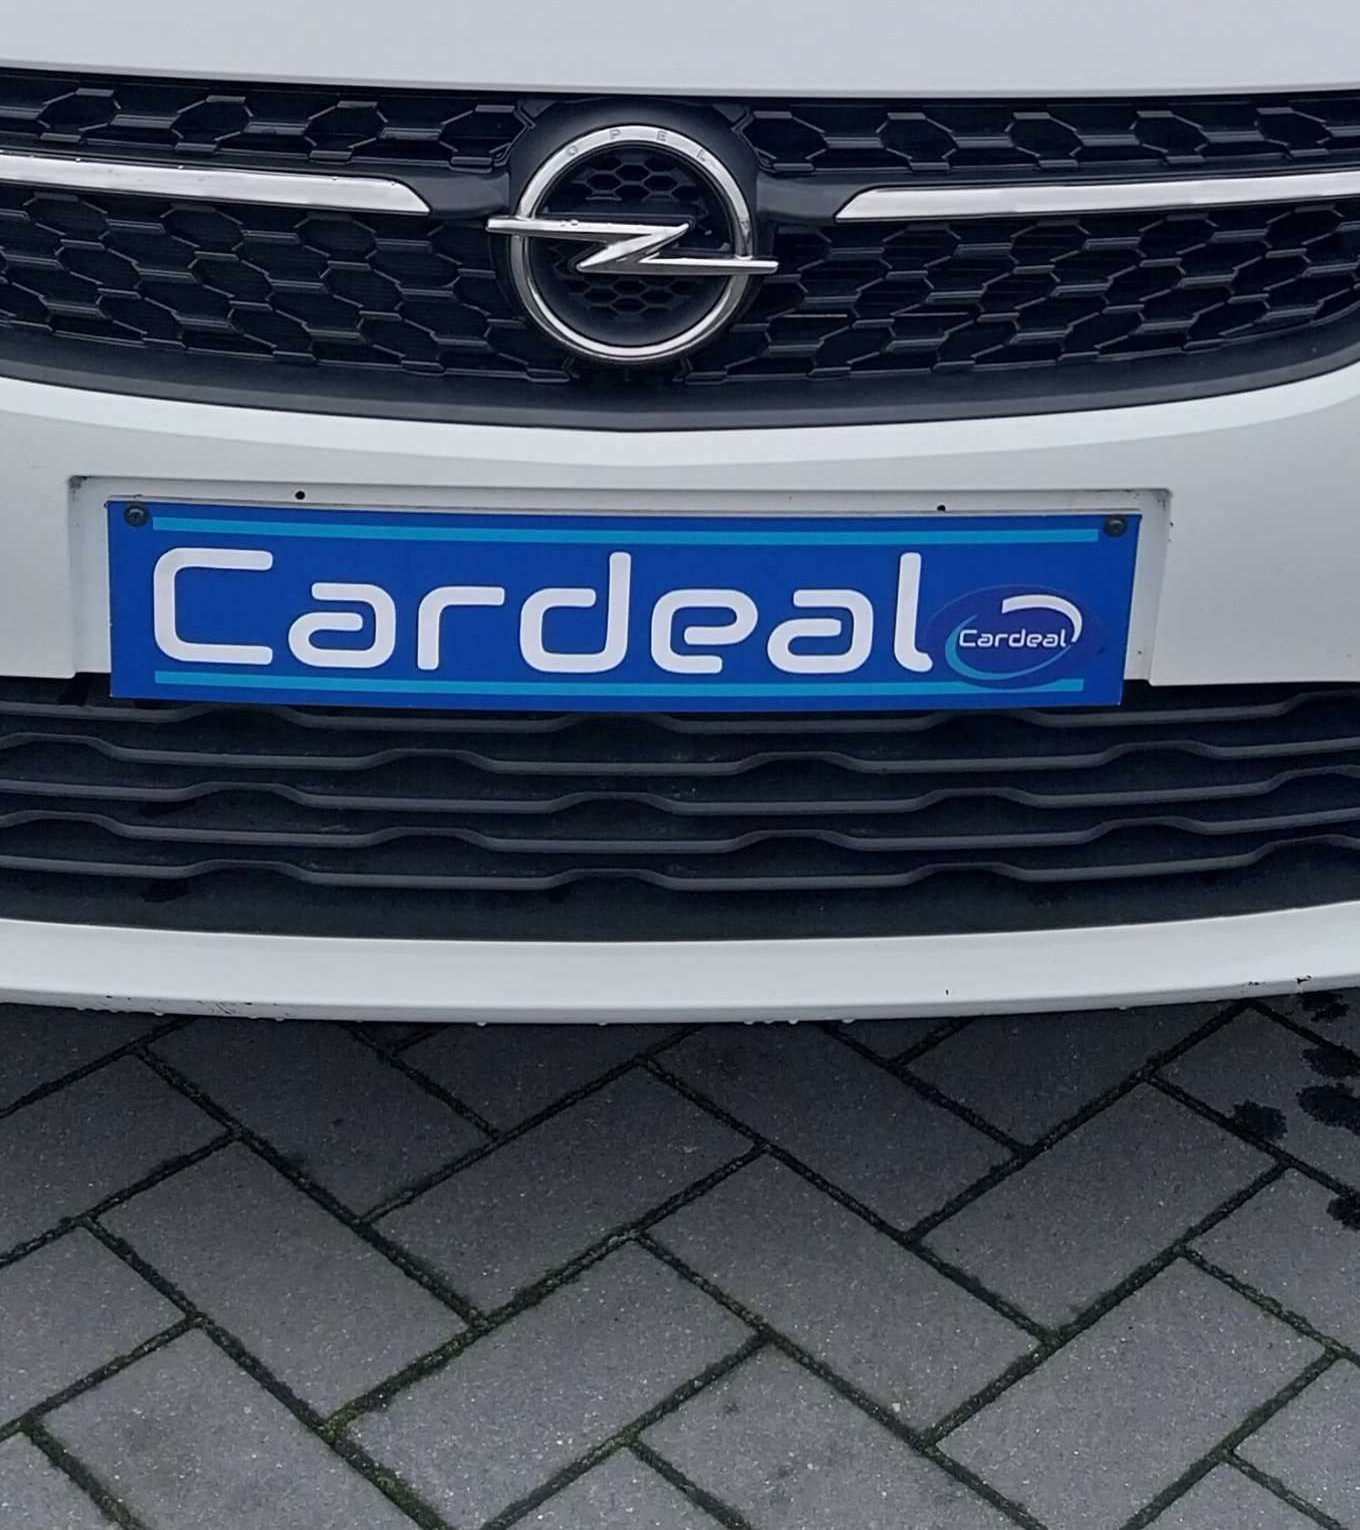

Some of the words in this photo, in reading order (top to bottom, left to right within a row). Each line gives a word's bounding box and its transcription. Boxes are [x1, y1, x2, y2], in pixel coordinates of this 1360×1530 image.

[566, 128, 707, 162] OPEL
[153, 547, 934, 674] Cardeal
[959, 628, 1067, 648] Cardeal
